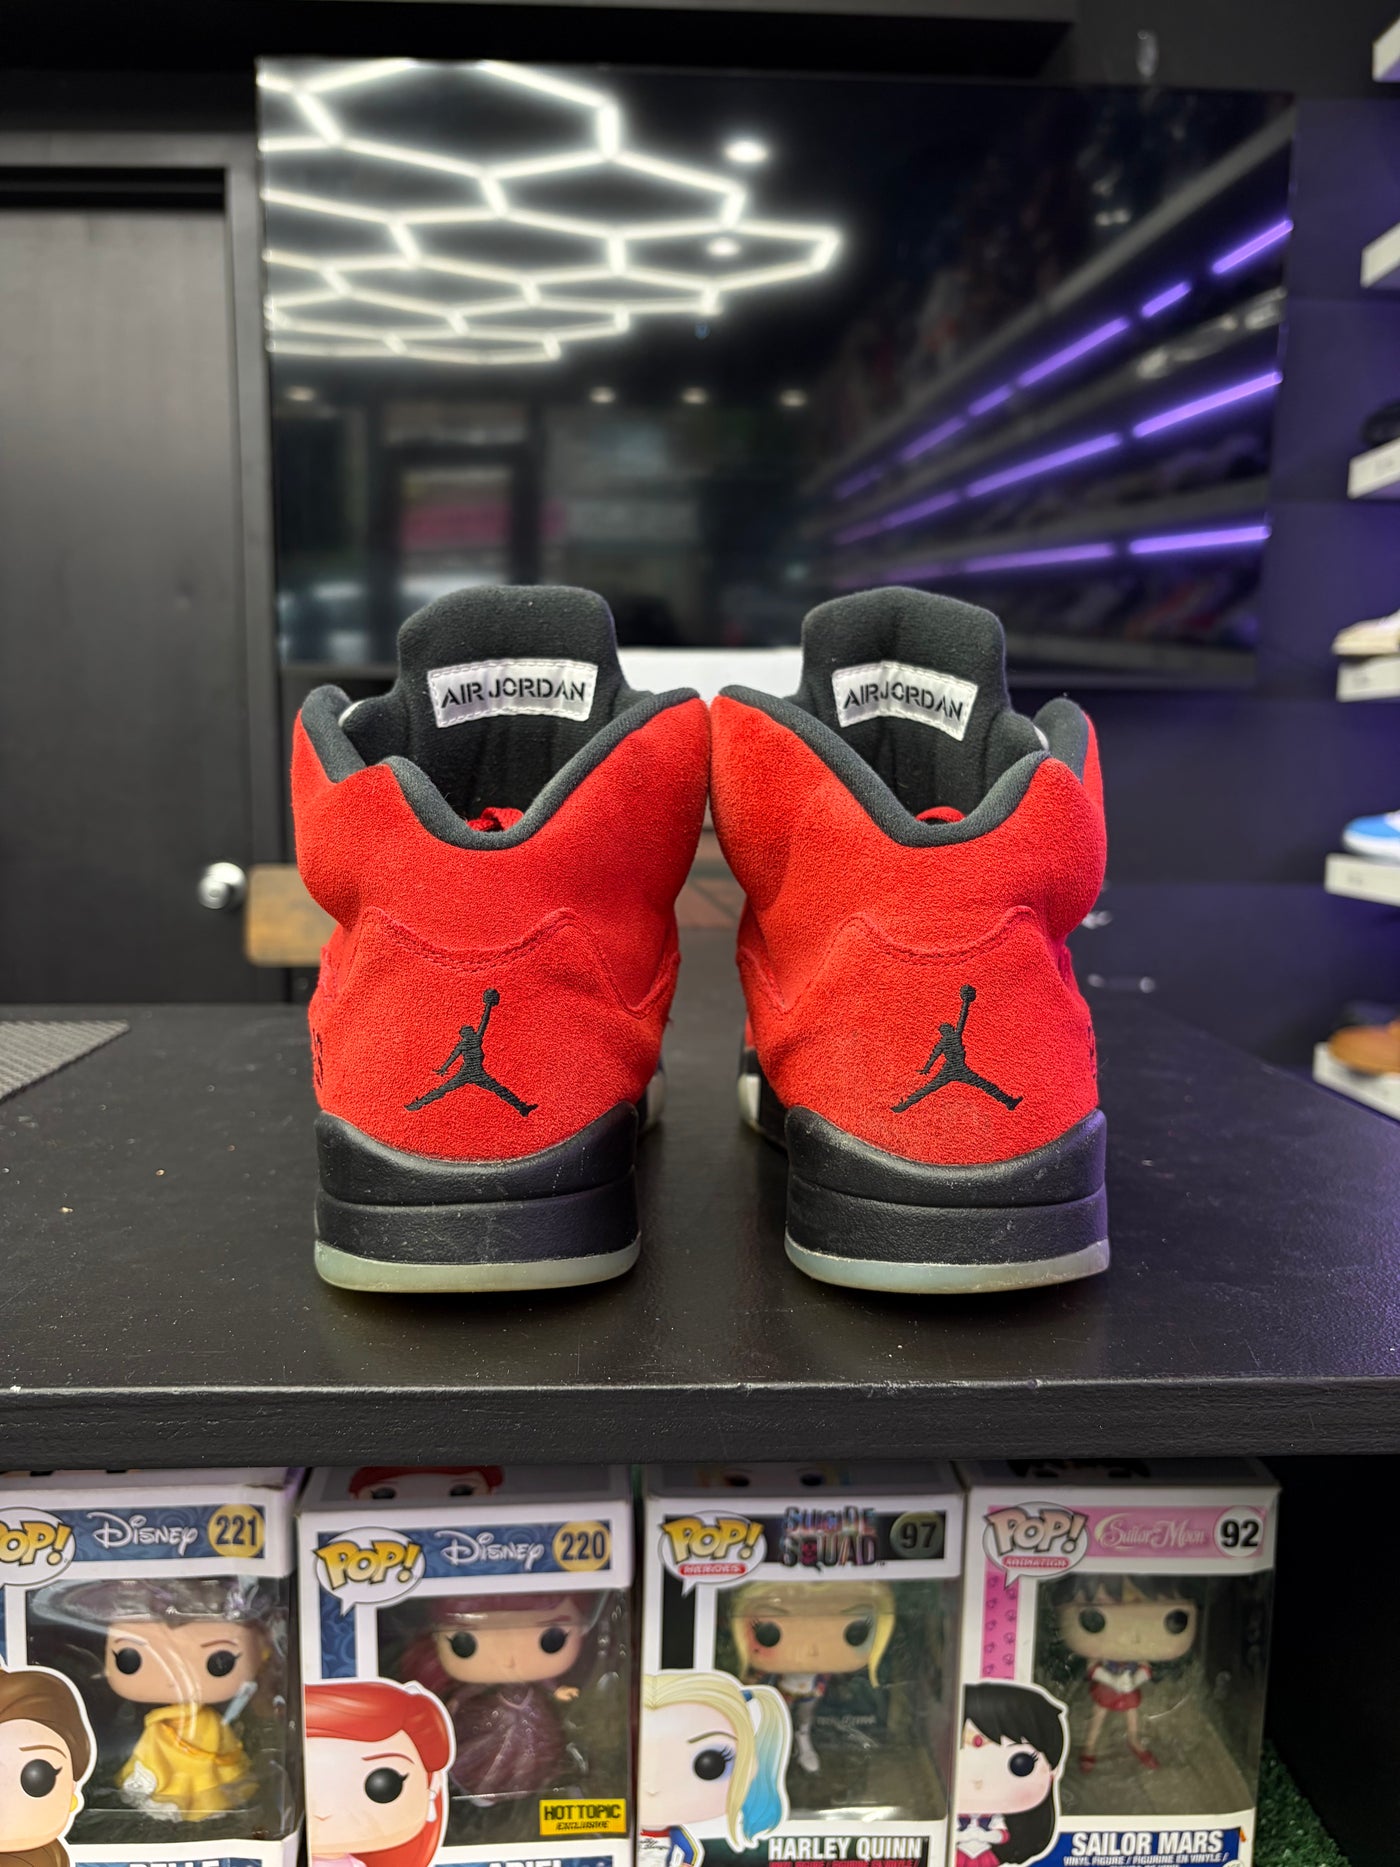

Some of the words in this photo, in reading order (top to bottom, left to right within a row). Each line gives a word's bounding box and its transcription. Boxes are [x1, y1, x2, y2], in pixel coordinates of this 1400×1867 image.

[441, 681, 486, 708] AIR
[489, 677, 586, 701] JORDAN
[844, 684, 881, 708] AIR
[881, 681, 963, 721] JORDAN
[0, 1519, 73, 1567] OP!
[214, 1514, 257, 1546] 221
[660, 1516, 765, 1564] POP!
[901, 1522, 937, 1549] 97
[985, 1507, 1089, 1556] POP!
[1221, 1519, 1259, 1548] 92
[561, 1531, 605, 1561] 220
[781, 1532, 877, 1572] SQUAD
[312, 1539, 422, 1591] POP!
[544, 1804, 576, 1821] HOT
[577, 1804, 621, 1819] TOPIC
[768, 1837, 848, 1861] HARLEY
[855, 1836, 922, 1862] QUINN
[1071, 1832, 1152, 1856] SAILOR
[1157, 1829, 1223, 1854] MARS
[1092, 1856, 1124, 1865] FIGURE
